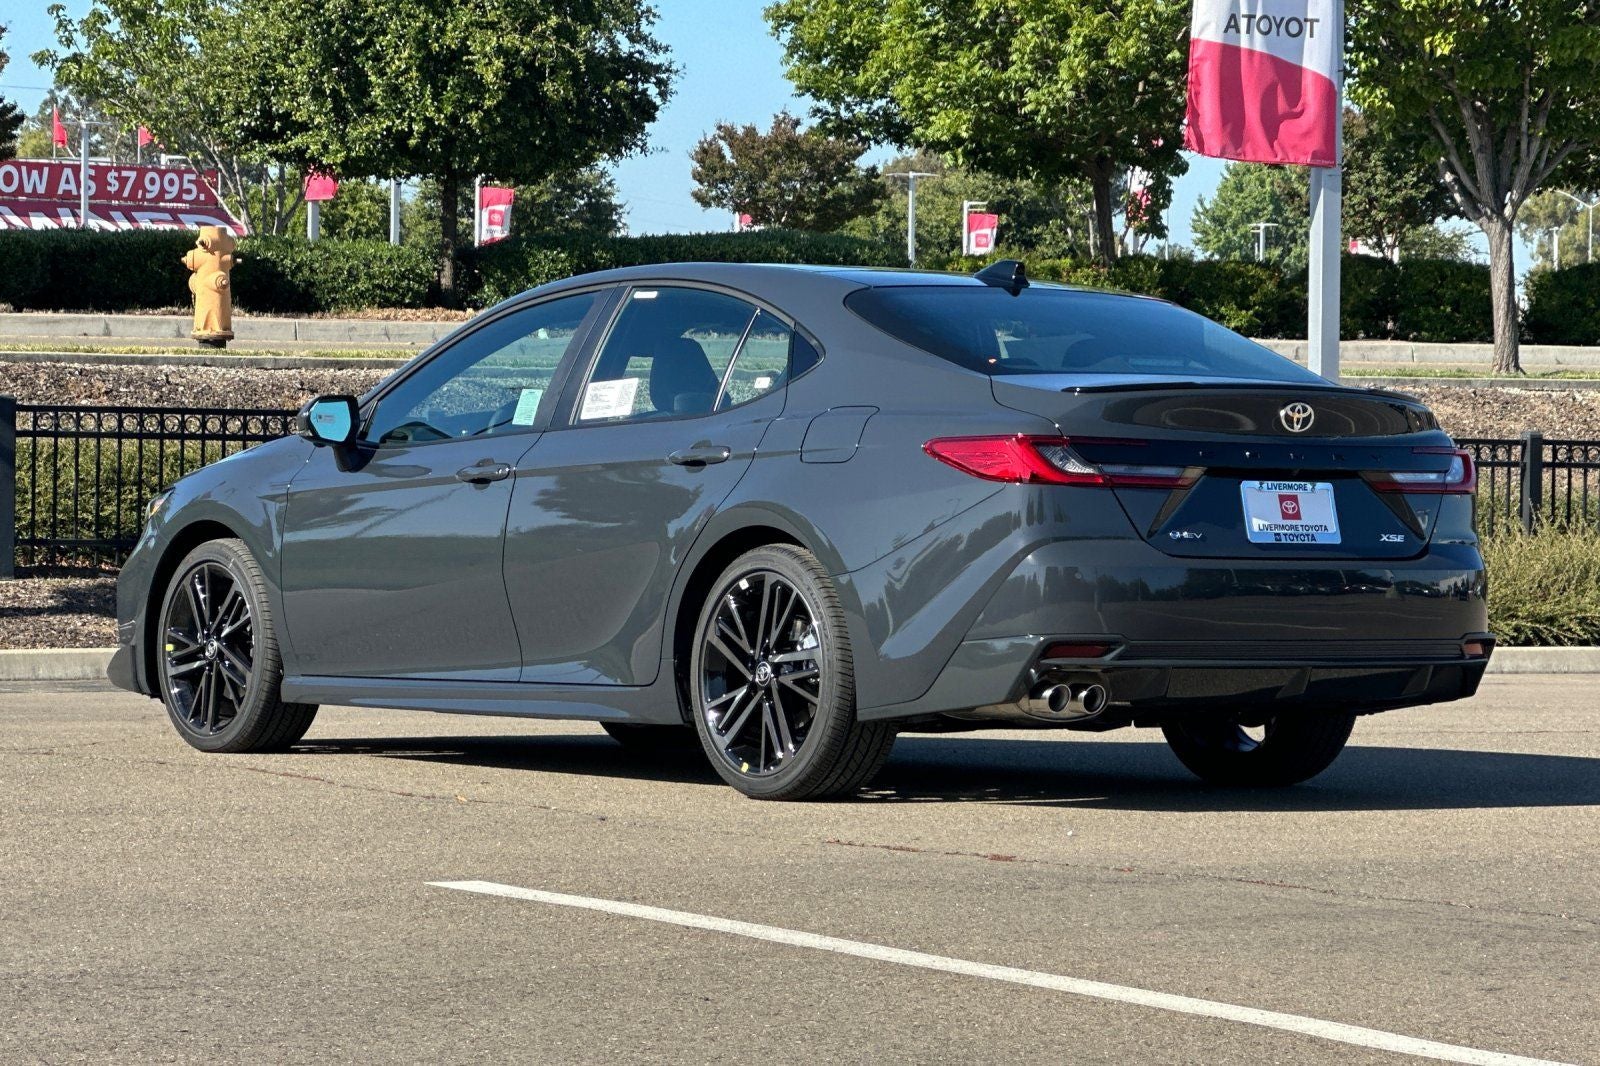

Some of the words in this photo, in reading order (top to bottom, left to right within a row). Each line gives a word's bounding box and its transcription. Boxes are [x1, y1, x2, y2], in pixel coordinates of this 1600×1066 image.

[1266, 482, 1308, 491] LIVERMORE
[1258, 524, 1299, 532] LIVERMORE
[1283, 533, 1317, 542] TOYOTA
[1379, 533, 1405, 542] XSE
